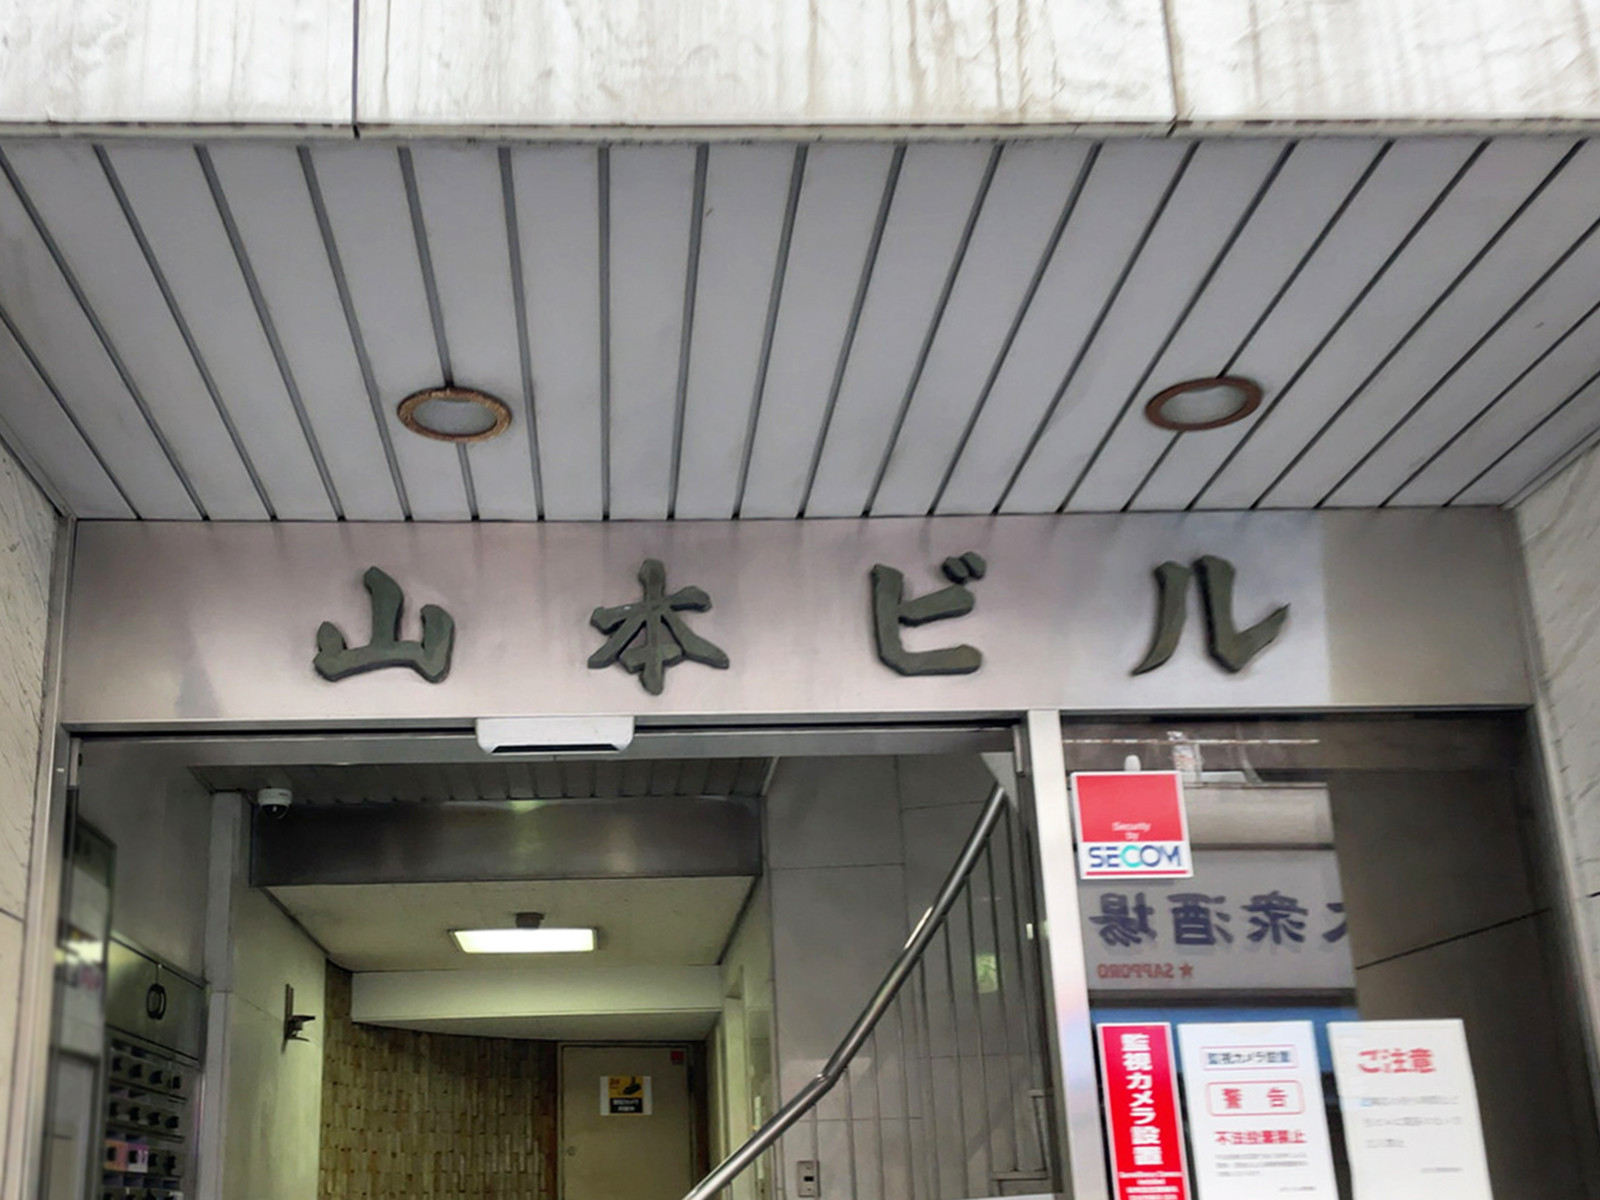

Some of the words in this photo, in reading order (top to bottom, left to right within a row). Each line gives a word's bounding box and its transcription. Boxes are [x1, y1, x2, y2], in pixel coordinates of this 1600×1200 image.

[313, 552, 1292, 695] 山本ビル
[1089, 845, 1182, 868] SECOM
[1120, 1033, 1164, 1166] 監視カメラ設置
[1358, 1048, 1437, 1073] ご注意
